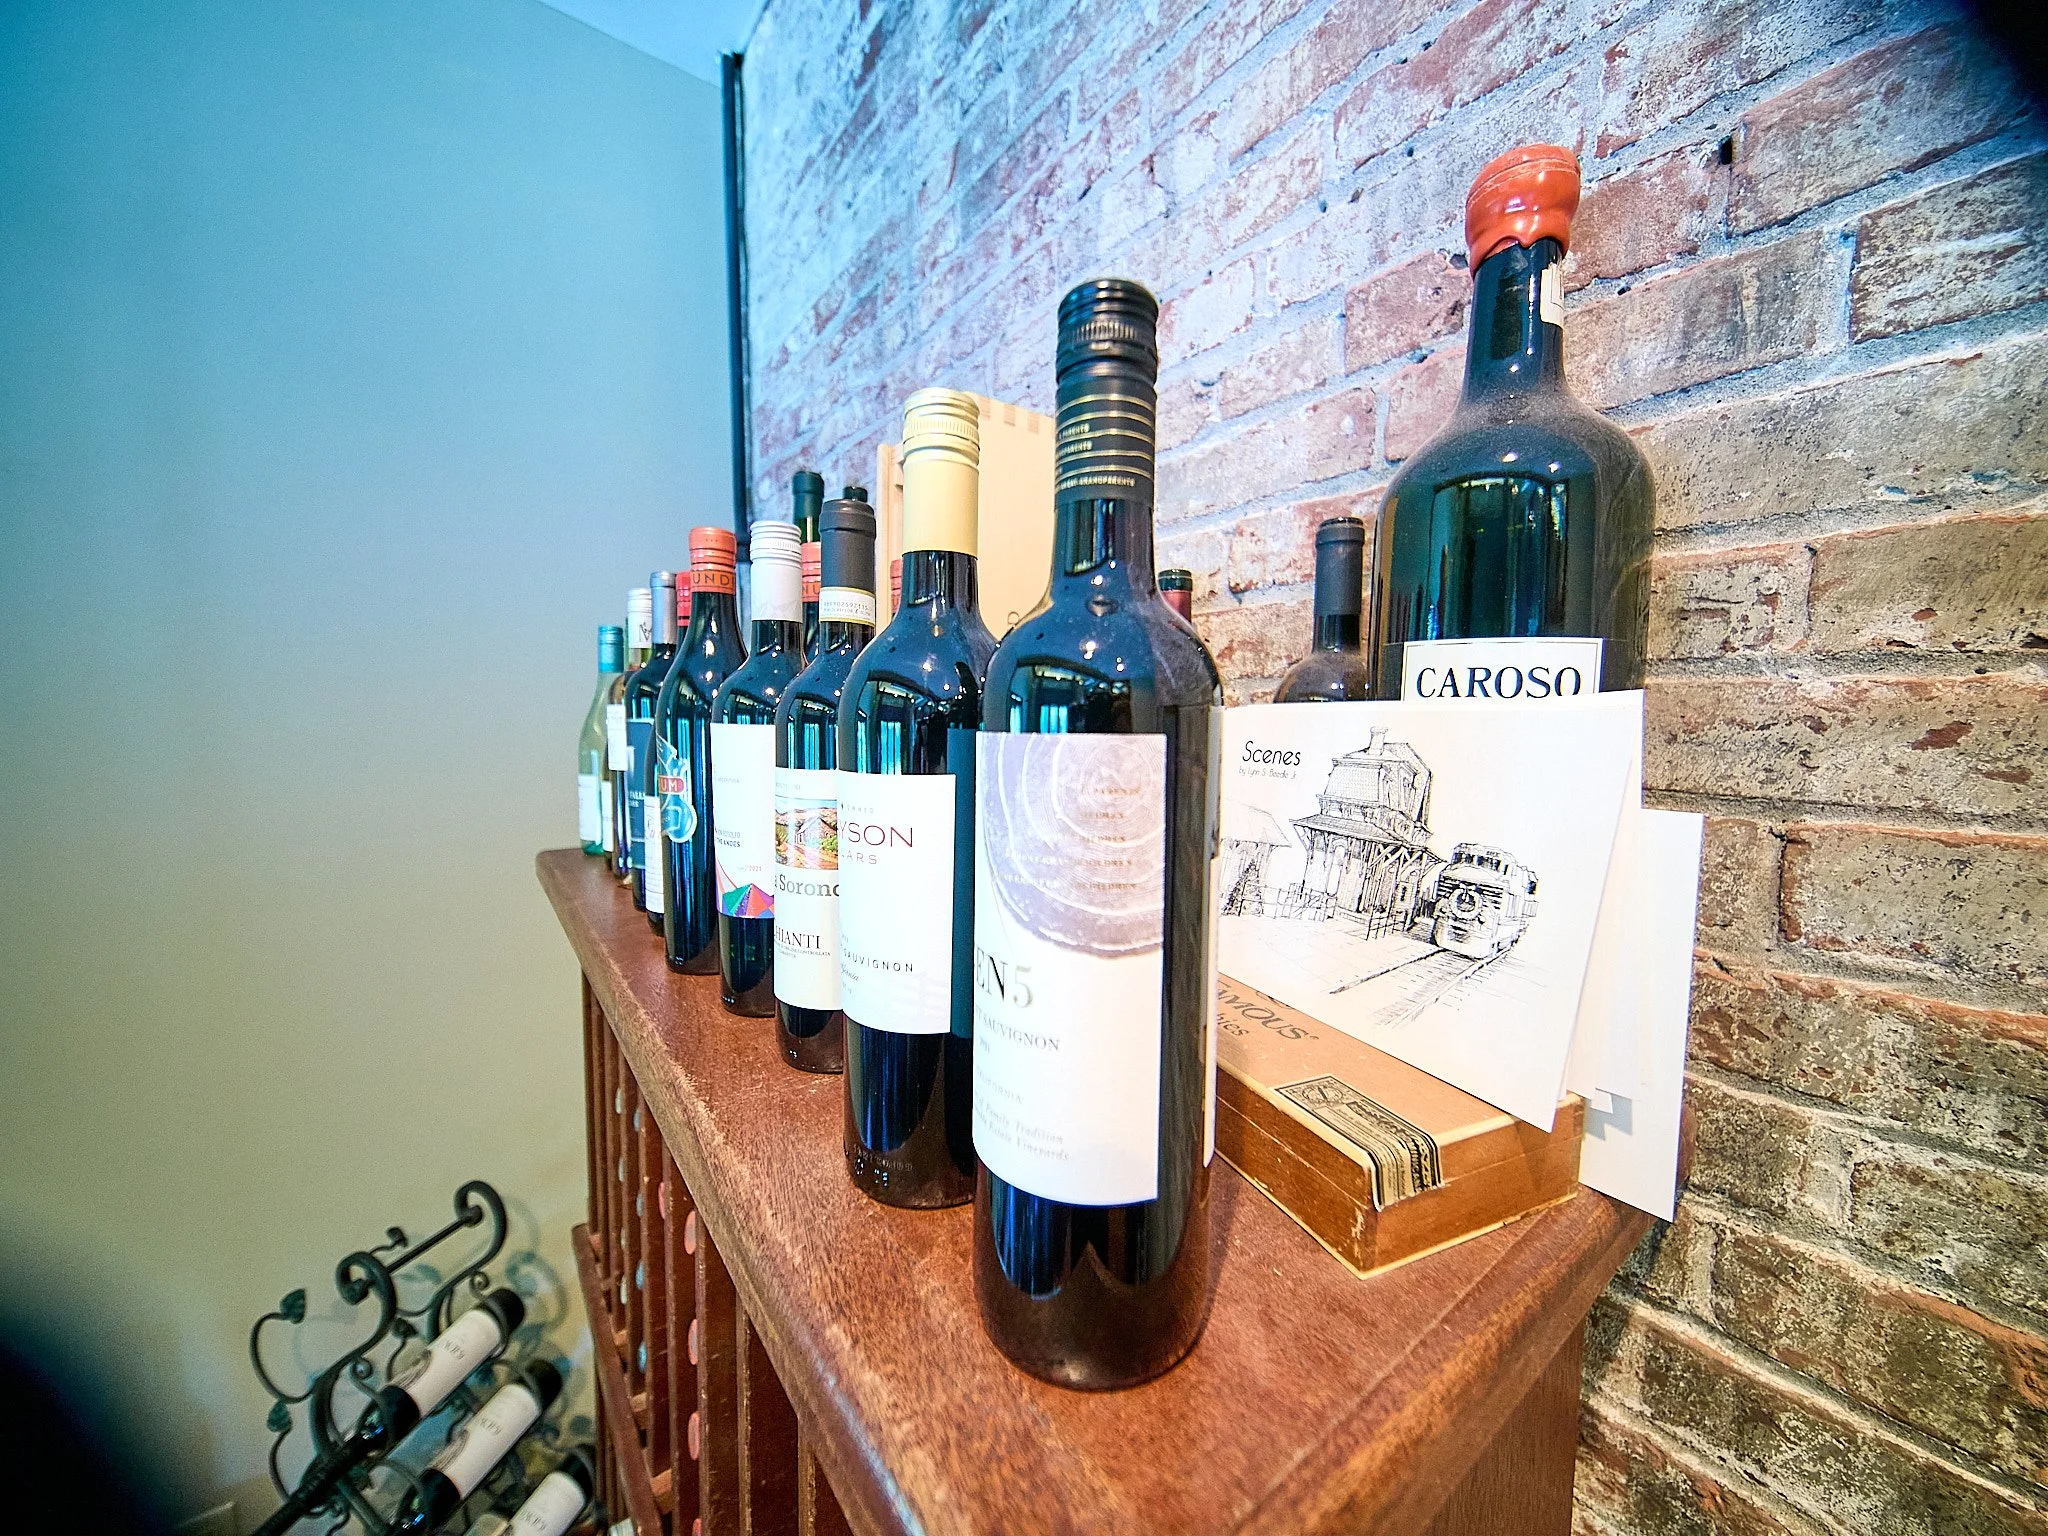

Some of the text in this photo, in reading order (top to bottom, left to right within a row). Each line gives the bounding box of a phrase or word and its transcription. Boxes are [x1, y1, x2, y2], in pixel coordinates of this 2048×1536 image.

[1416, 666, 1582, 699] CAROSO
[1242, 740, 1302, 767] Scenes
[841, 850, 878, 865] ARS
[774, 925, 821, 949] HIANTI
[843, 948, 913, 973] SAUVIGNON
[983, 1013, 1061, 1052] SAUVIGNON
